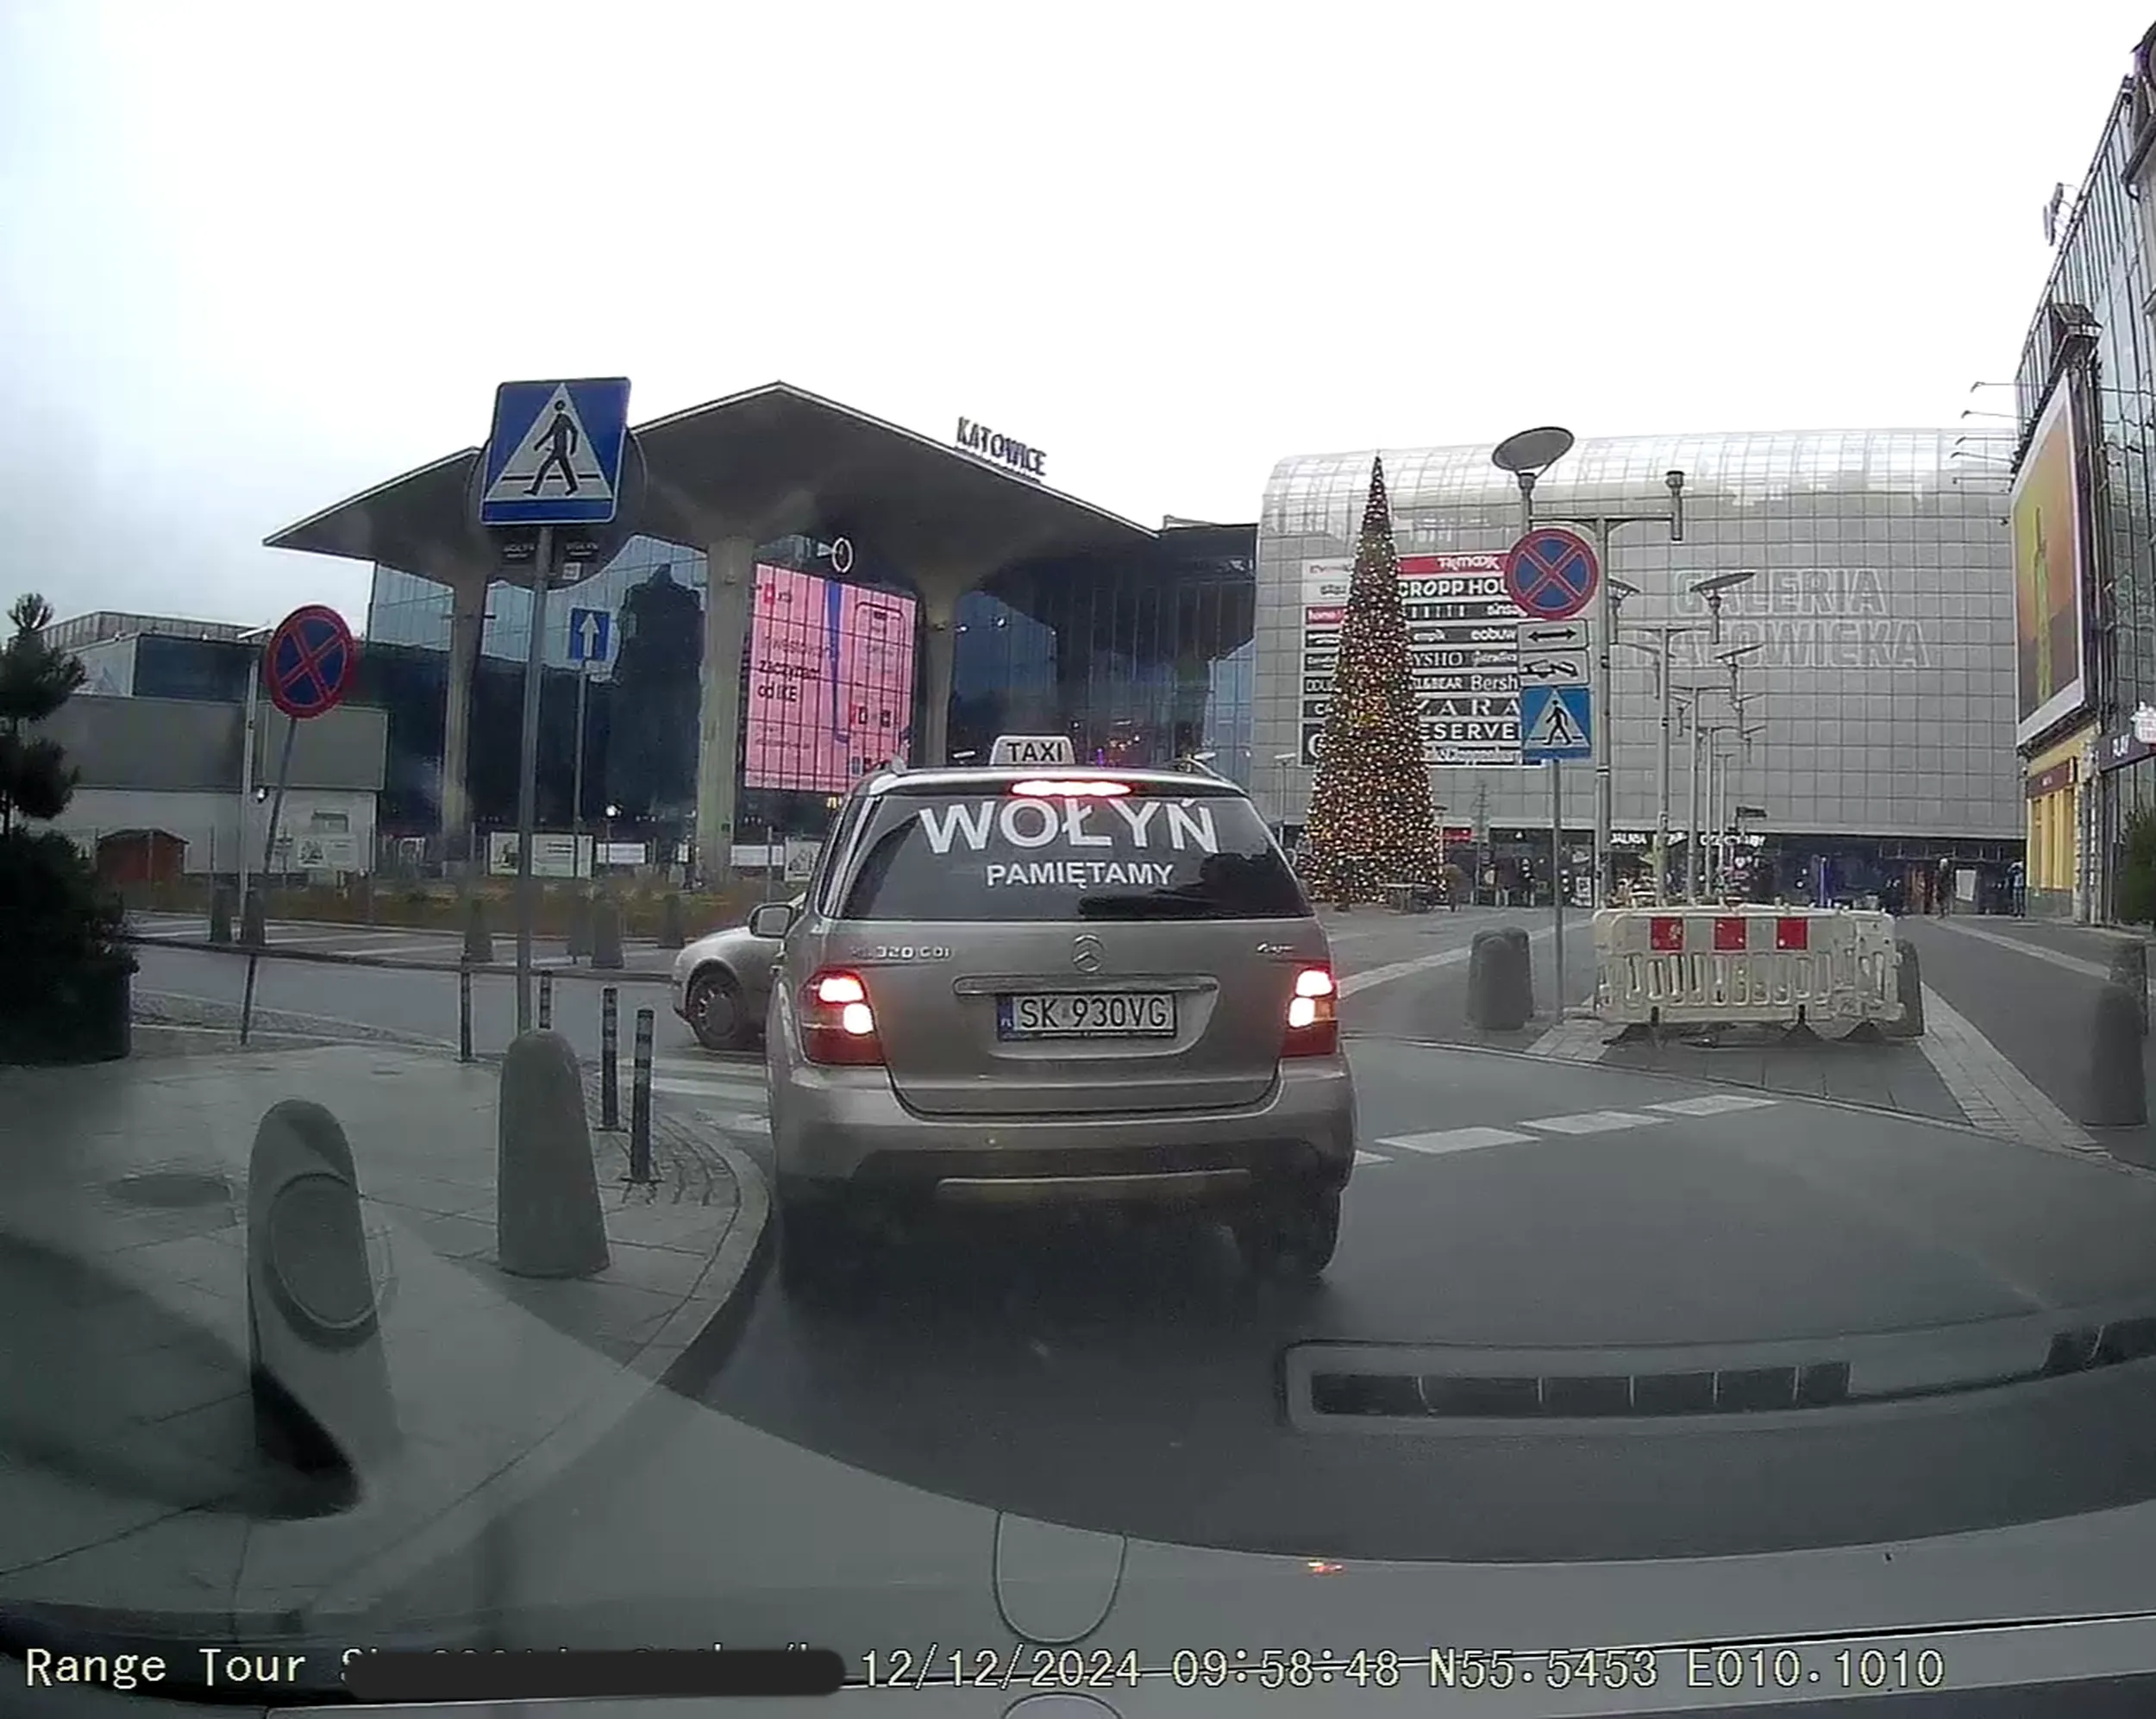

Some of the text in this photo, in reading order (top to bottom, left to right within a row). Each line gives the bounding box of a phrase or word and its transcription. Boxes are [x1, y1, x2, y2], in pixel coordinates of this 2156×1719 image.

[956, 416, 1047, 476] KATOWICE
[1413, 652, 1463, 667] YSHO
[1420, 724, 1516, 740] ESERVE
[1006, 742, 1063, 762] TAXI
[918, 799, 1219, 854] WOŁYŃ
[987, 863, 1174, 889] PAMIĘTAMY
[1020, 997, 1166, 1029] SK 930VG
